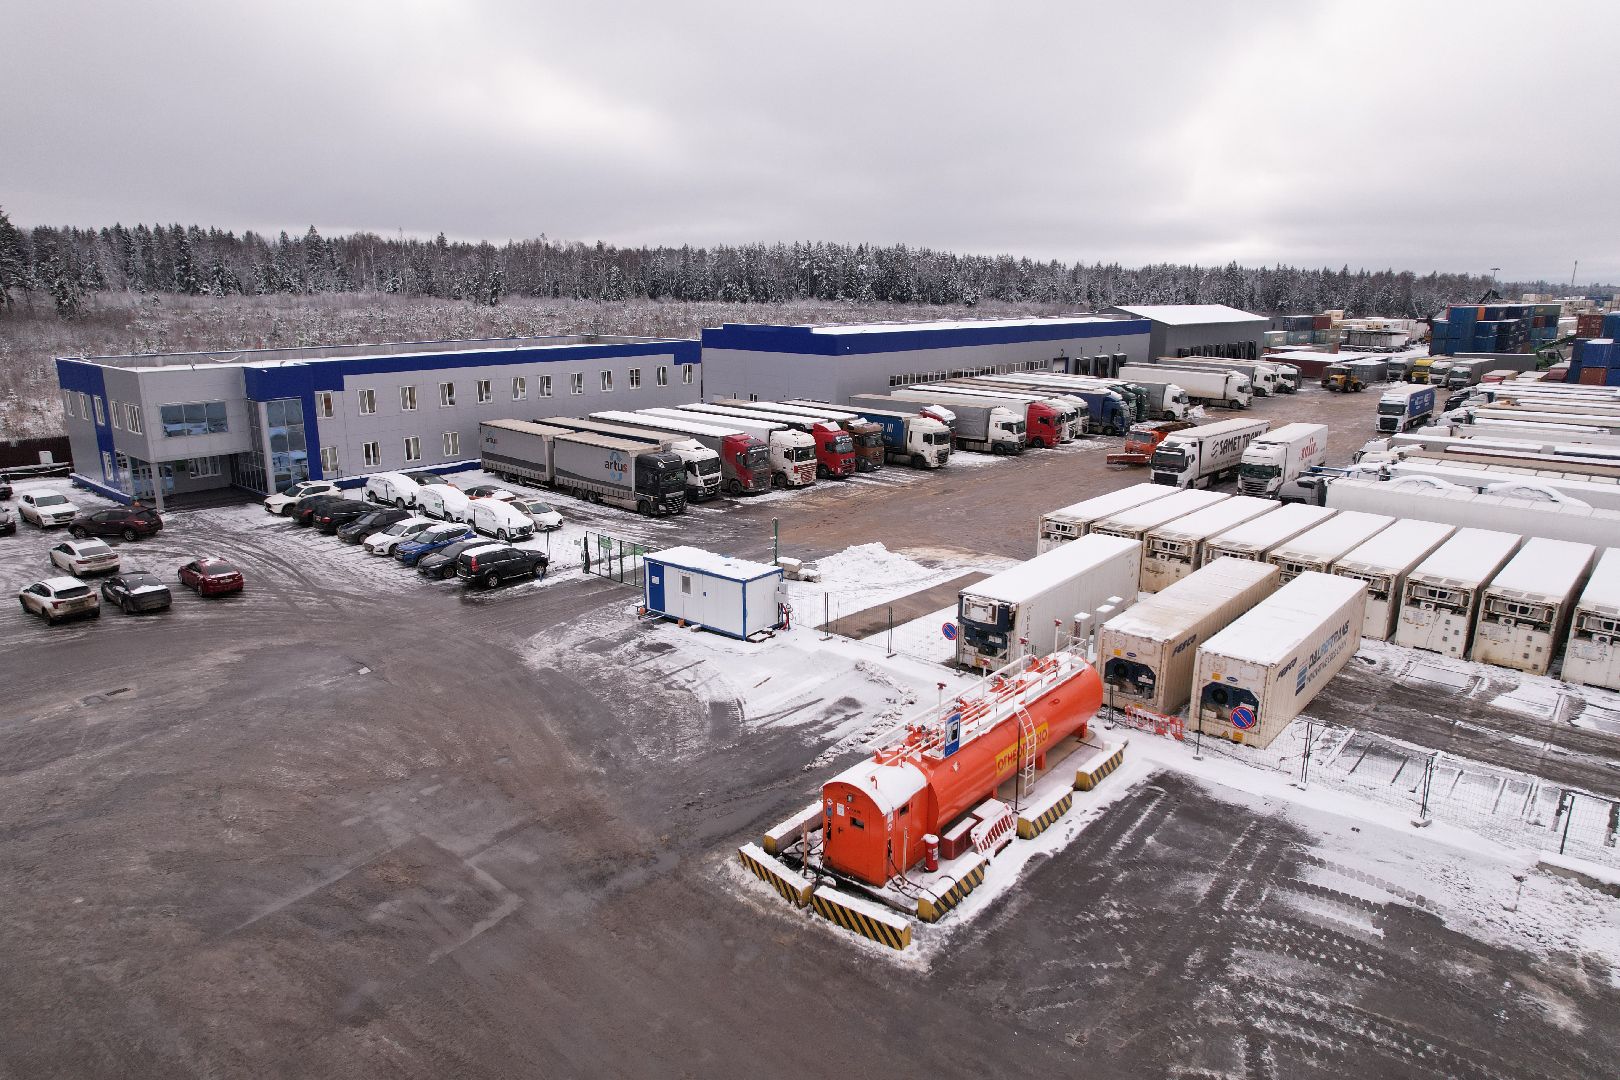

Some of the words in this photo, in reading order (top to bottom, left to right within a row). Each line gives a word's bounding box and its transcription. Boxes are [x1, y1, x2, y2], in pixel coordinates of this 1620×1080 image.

[1219, 436, 1242, 456] SAMET
[604, 460, 628, 473] artus
[997, 729, 1048, 770] ОГНЕОПАНО
